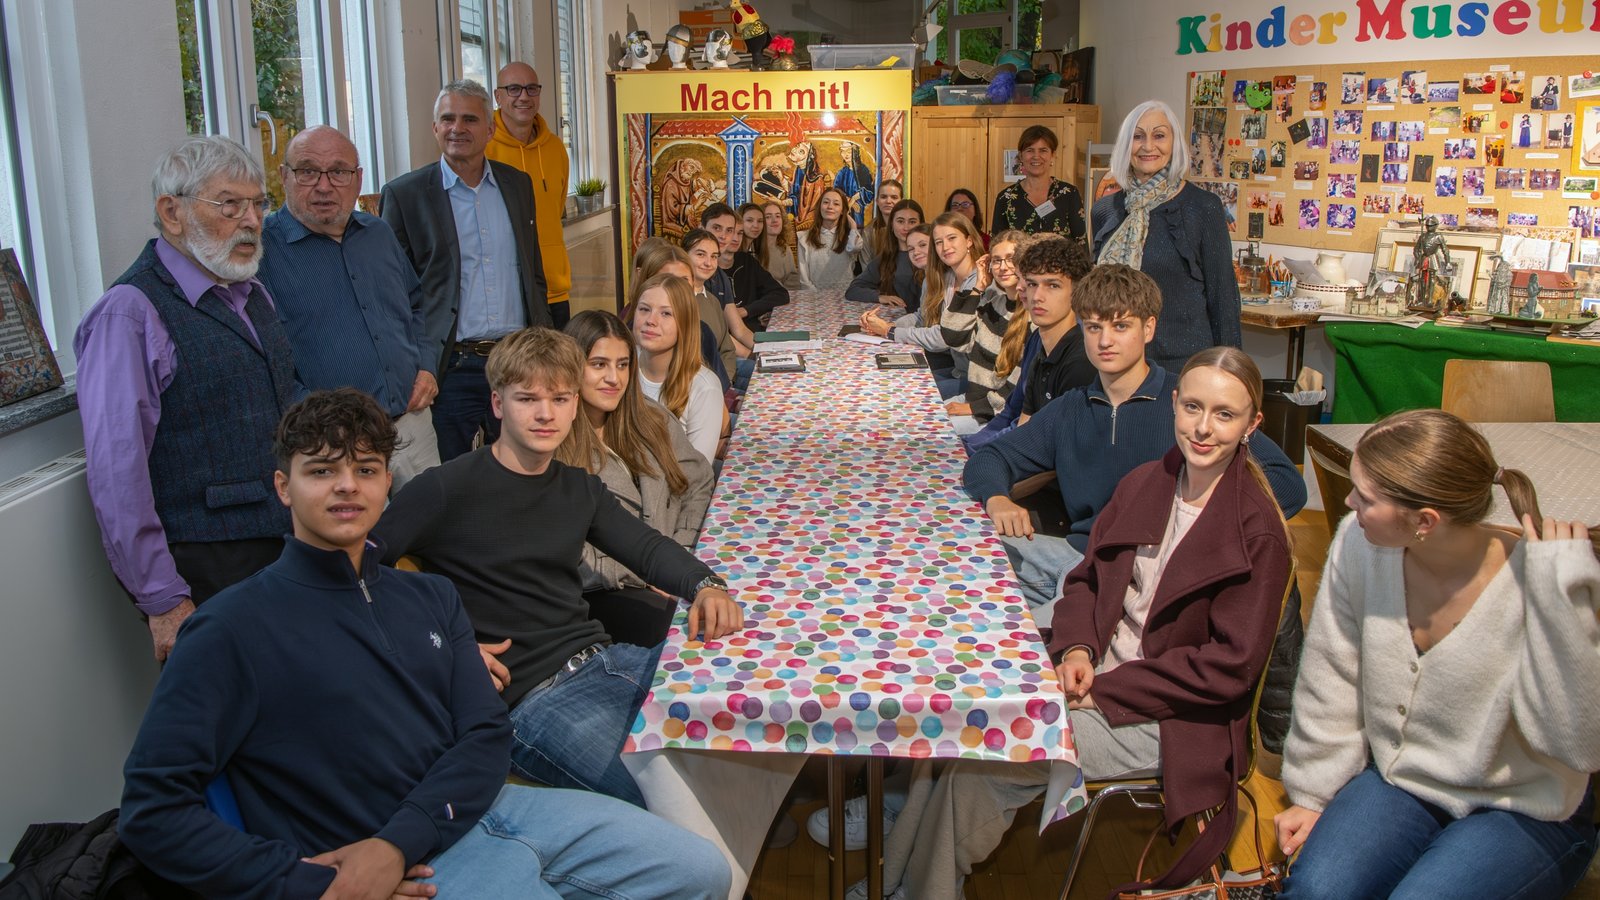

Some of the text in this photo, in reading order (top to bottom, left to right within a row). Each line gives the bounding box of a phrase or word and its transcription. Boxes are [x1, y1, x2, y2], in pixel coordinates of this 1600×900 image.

[1175, 6, 1347, 55] Kinder
[681, 81, 850, 111] Mach mit!
